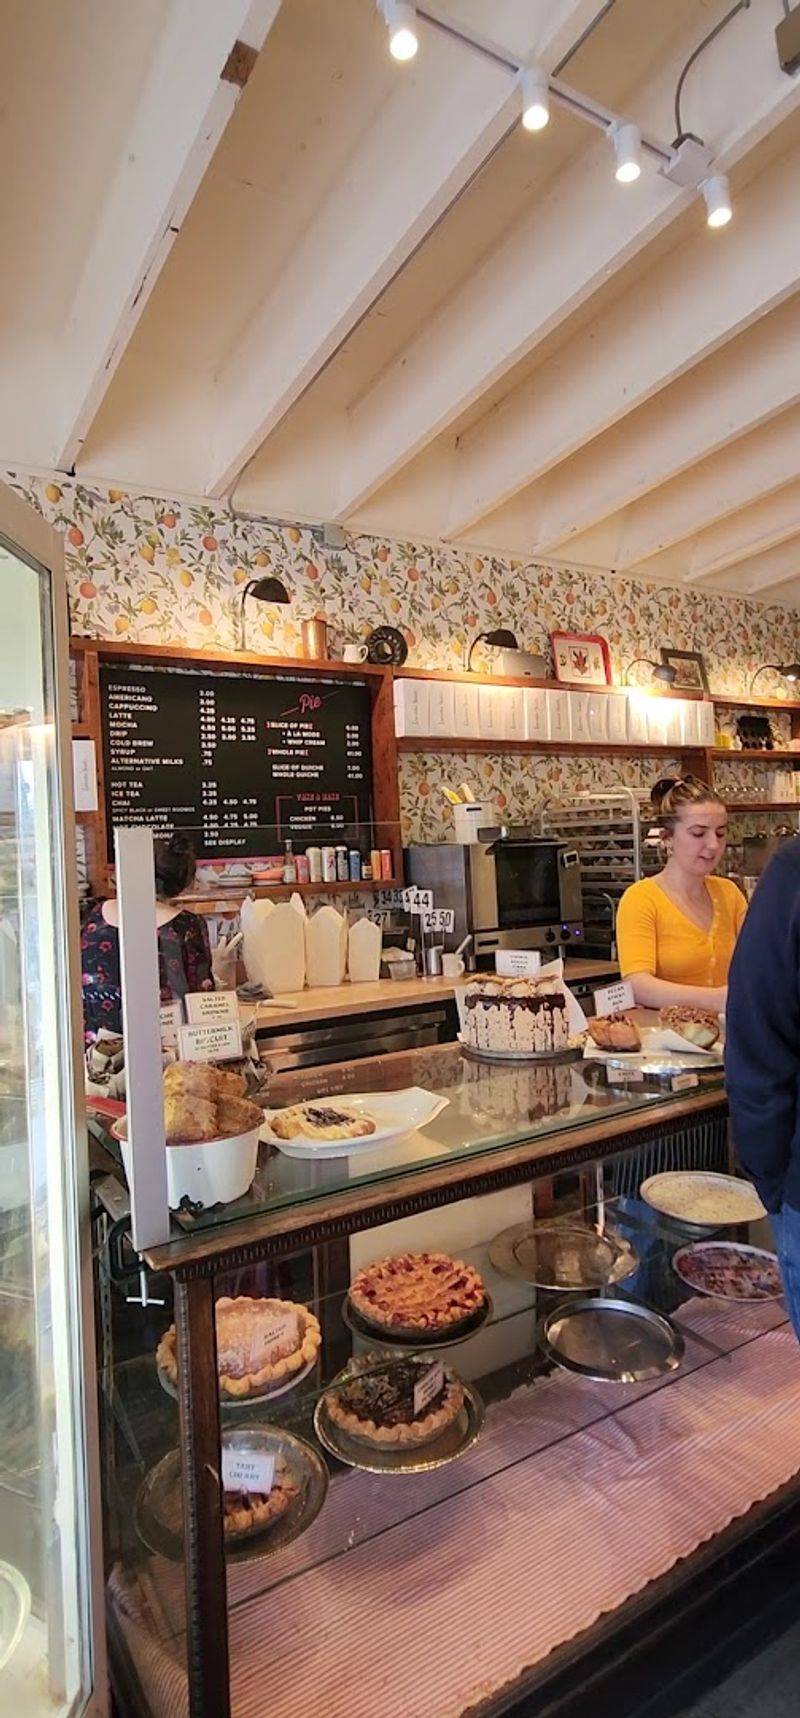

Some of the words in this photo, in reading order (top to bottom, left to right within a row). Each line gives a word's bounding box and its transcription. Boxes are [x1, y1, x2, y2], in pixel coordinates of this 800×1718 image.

[108, 684, 146, 693] ESPRESSO
[108, 693, 153, 703] AMERICANO
[299, 692, 322, 714] Pie
[108, 702, 158, 712] CAPPUCCINO
[110, 757, 160, 765] ALTERNATIVE
[145, 814, 168, 822] LATTE
[413, 892, 430, 908] 44
[425, 912, 437, 927] 25
[438, 911, 452, 926] 50
[188, 1026, 233, 1037] BUTTERMILK
